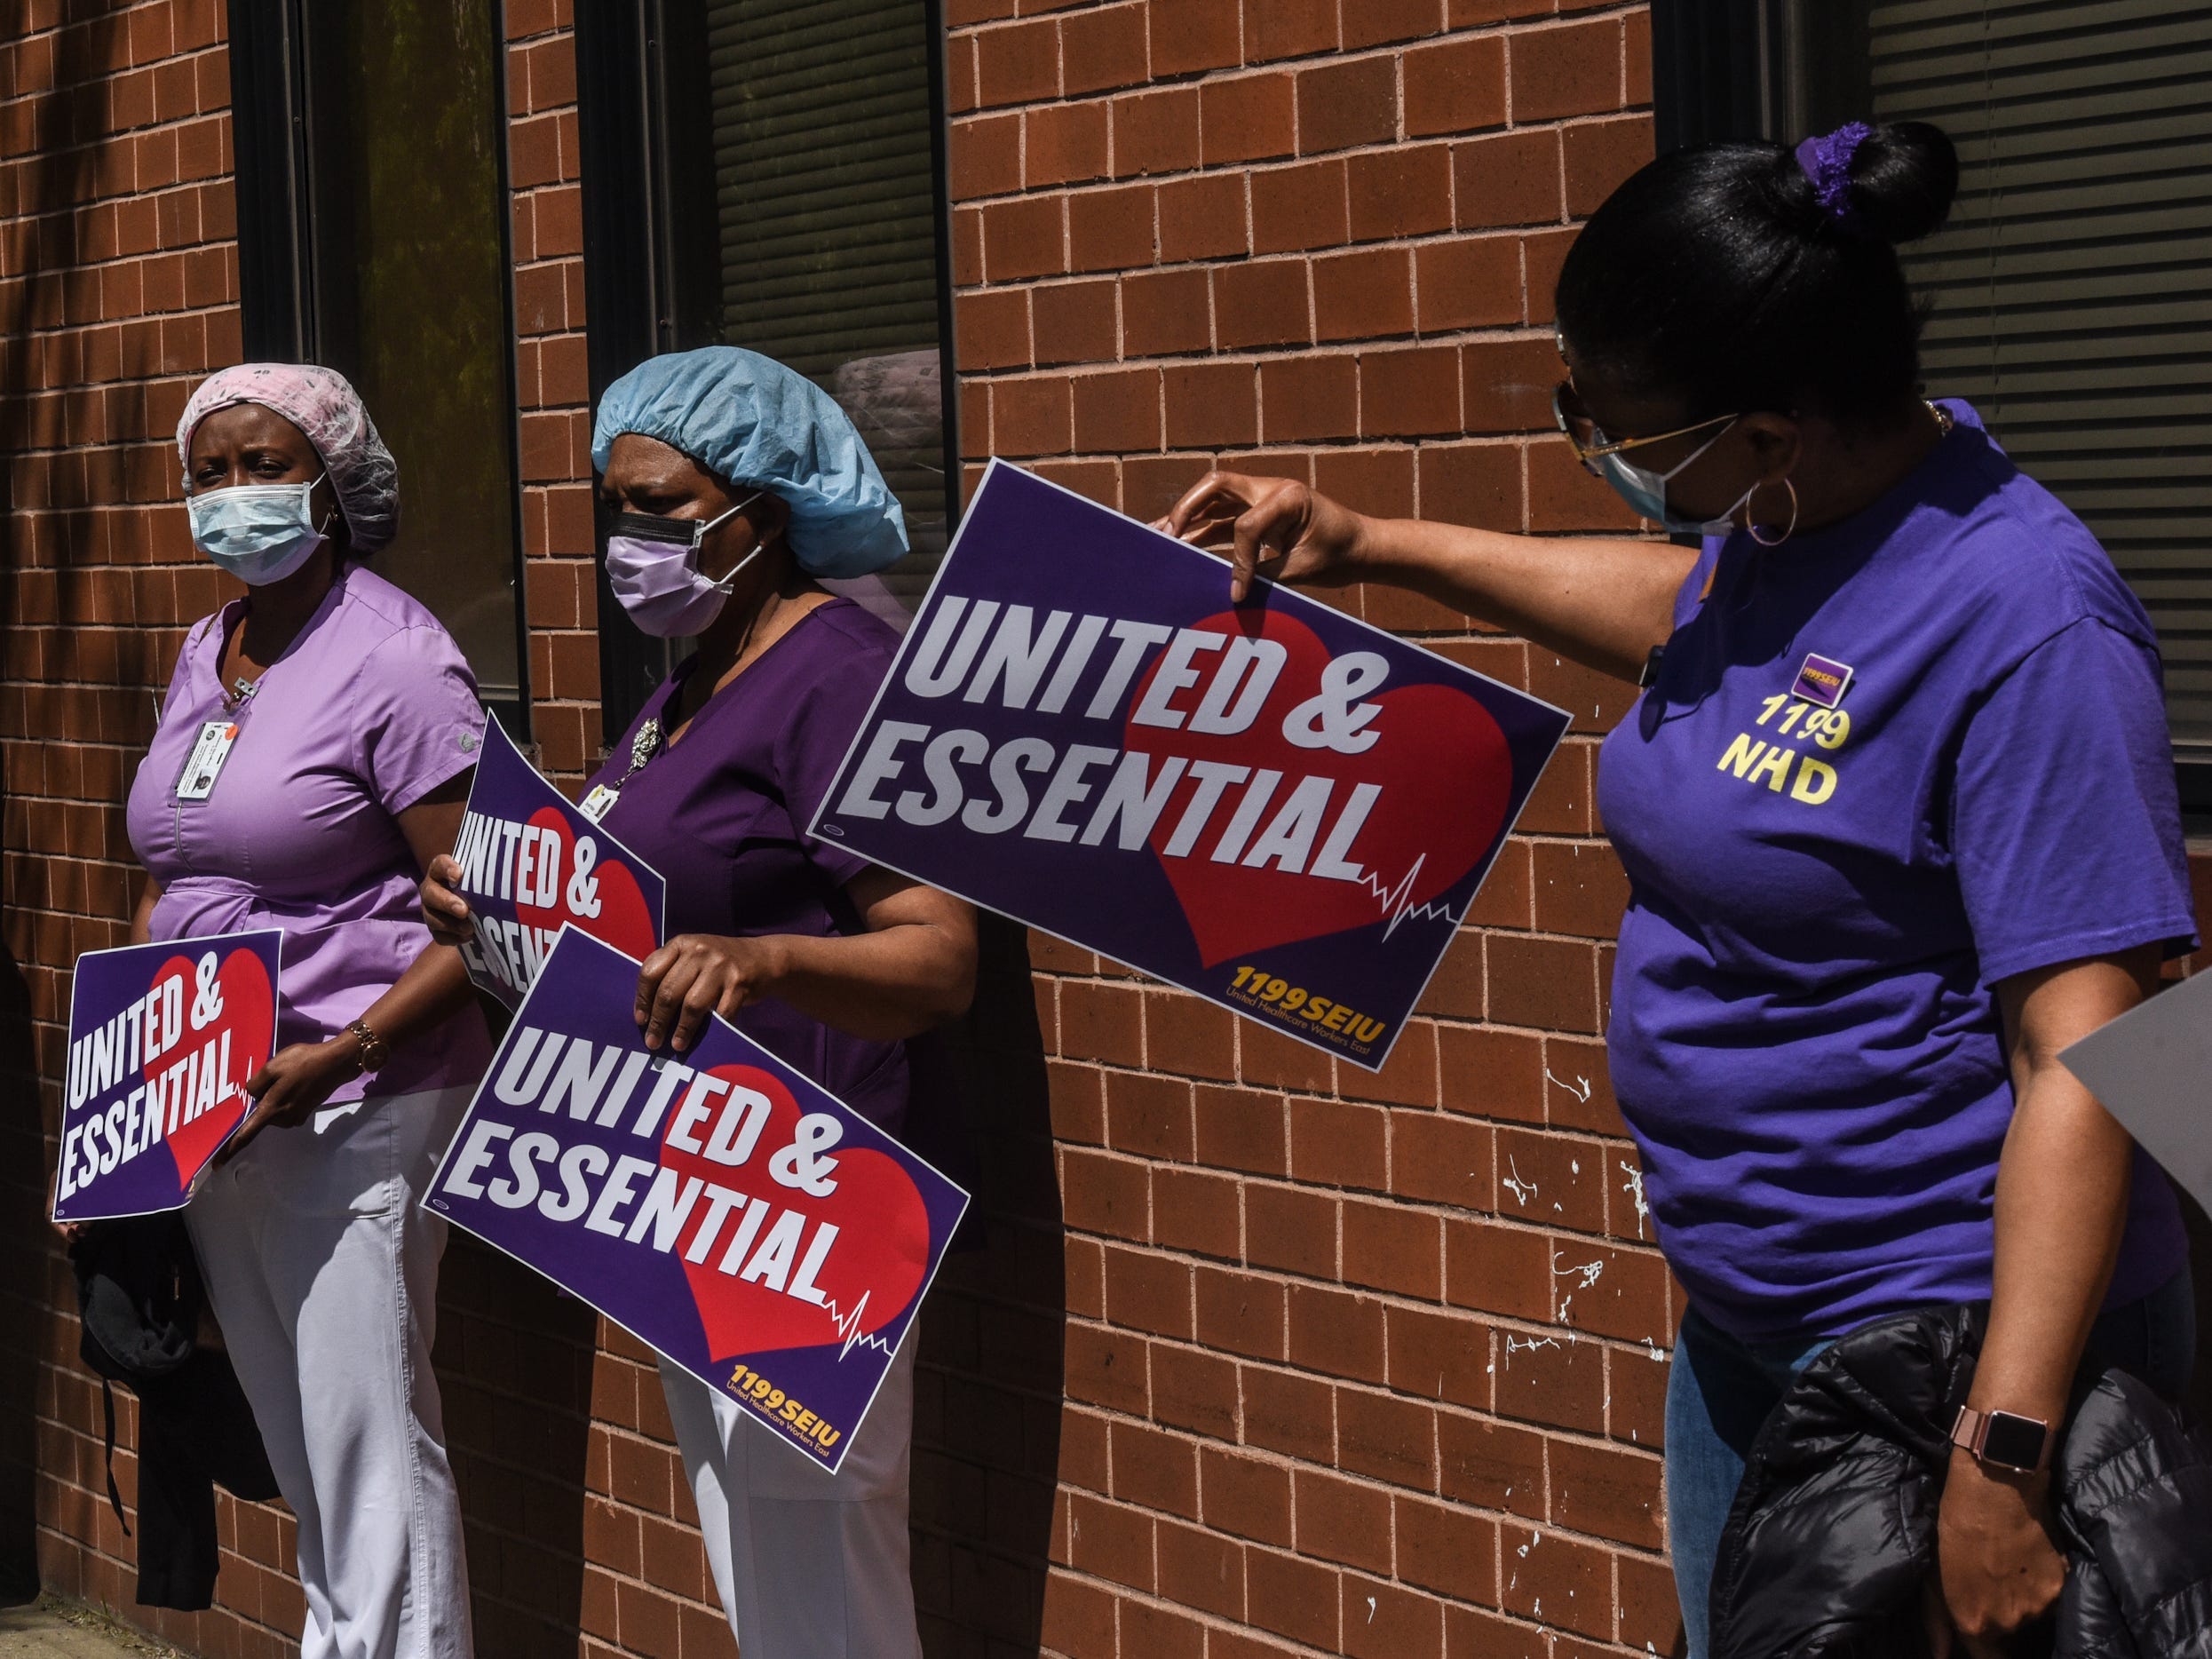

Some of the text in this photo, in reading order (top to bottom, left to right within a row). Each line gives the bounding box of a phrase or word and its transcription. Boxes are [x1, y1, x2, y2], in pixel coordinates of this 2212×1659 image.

[905, 595, 1391, 755] UNITED &
[1756, 694, 1851, 750] 1199
[836, 719, 1383, 882] ESSENTIAL
[1716, 733, 1838, 805] NHD
[566, 836, 602, 919] &
[461, 909, 559, 994] ESSEN
[69, 951, 224, 1110] UNITED &
[1225, 986, 1371, 1056] United Healthcare Workers East
[1232, 965, 1386, 1043] 1199SEIU
[59, 1028, 234, 1203] ESSENTIAL
[493, 1027, 844, 1198] UNITED &
[442, 1119, 840, 1306] ESSENTIAL
[726, 1379, 830, 1457] United Healthcare Workers East
[730, 1364, 842, 1448] 1199SEIU
